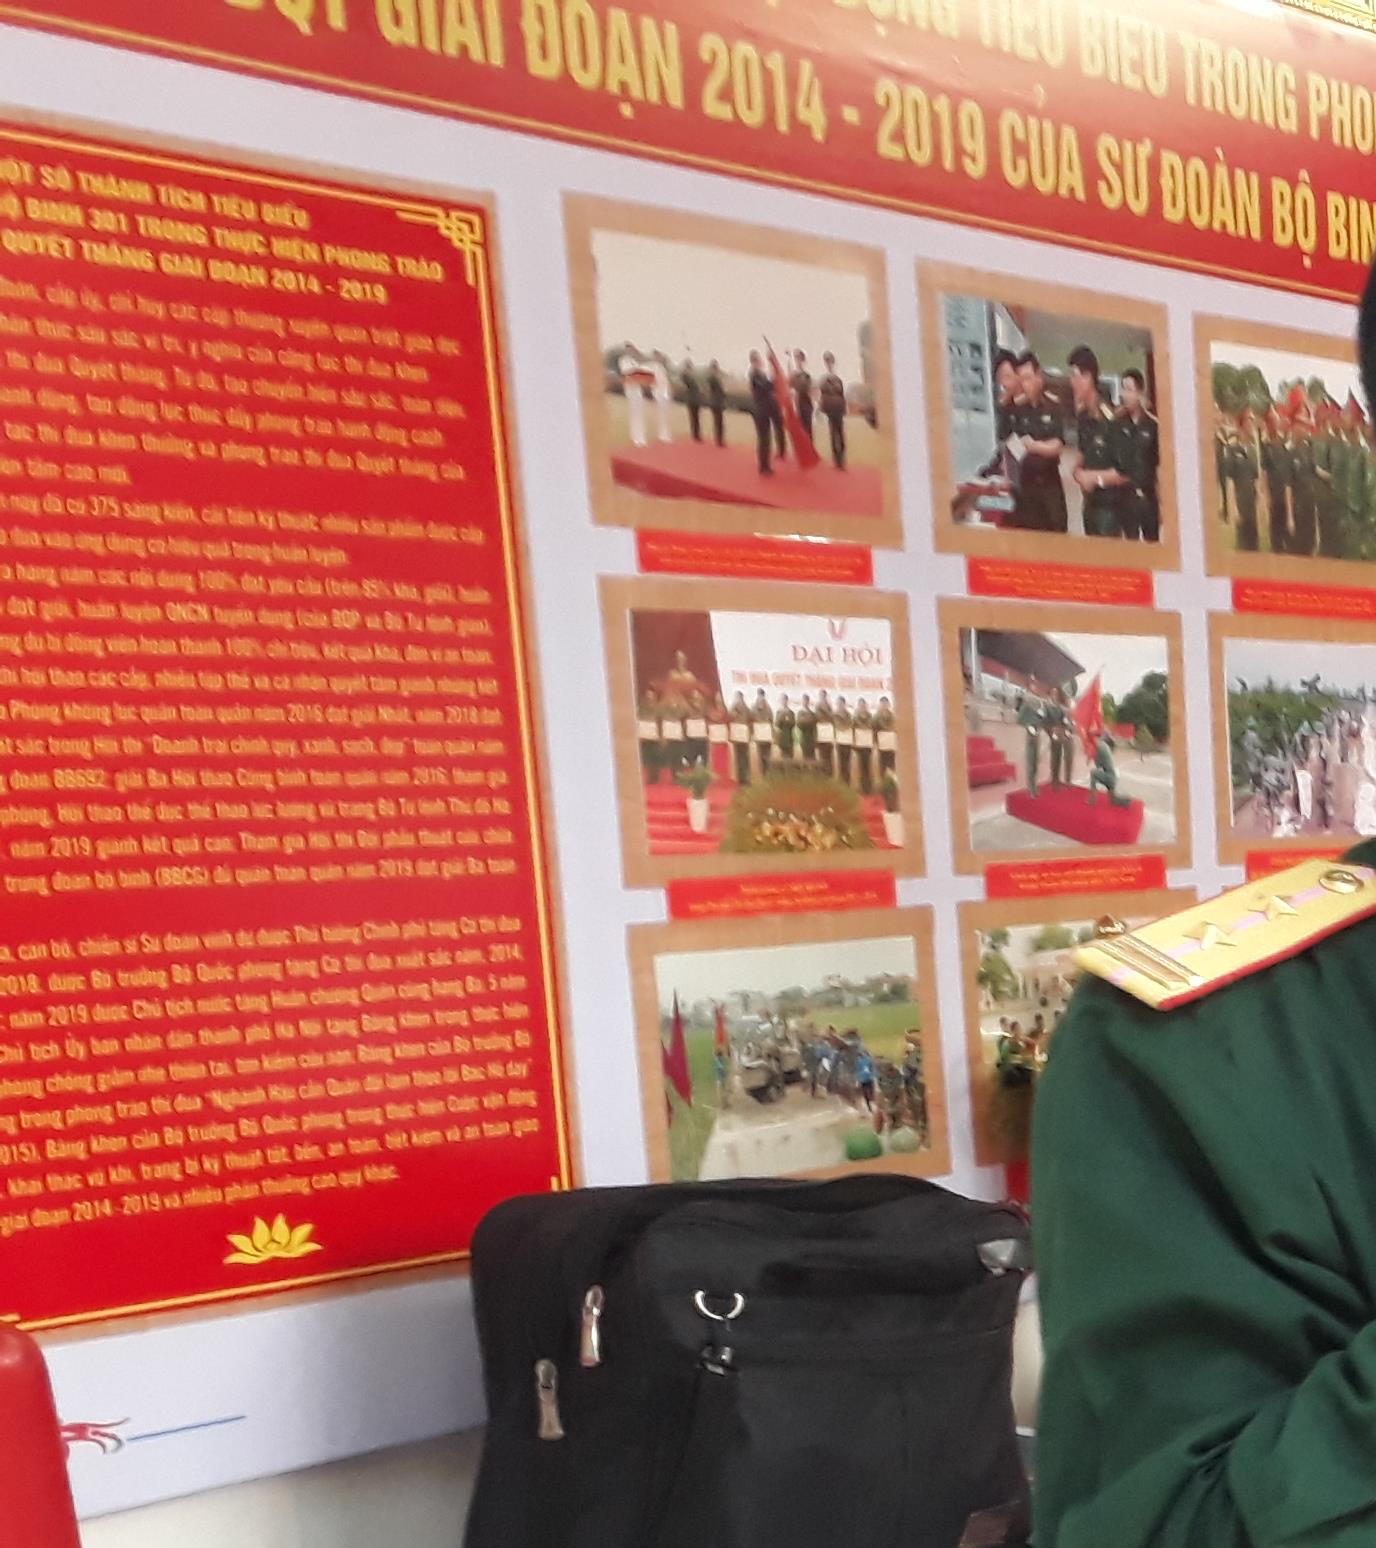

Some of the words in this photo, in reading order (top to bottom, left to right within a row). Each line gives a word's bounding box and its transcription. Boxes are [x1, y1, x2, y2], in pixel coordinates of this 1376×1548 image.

[521, 0, 684, 118] ĐOẠN
[700, 33, 827, 142] 2014
[874, 78, 986, 181] 2019
[999, 82, 1086, 204] CỦA
[1097, 131, 1152, 218] SƯ
[1159, 147, 1262, 242] ĐOÀN
[1271, 169, 1317, 268] BỘ
[1177, 31, 1299, 134] TRONG
[272, 268, 322, 294] 2014
